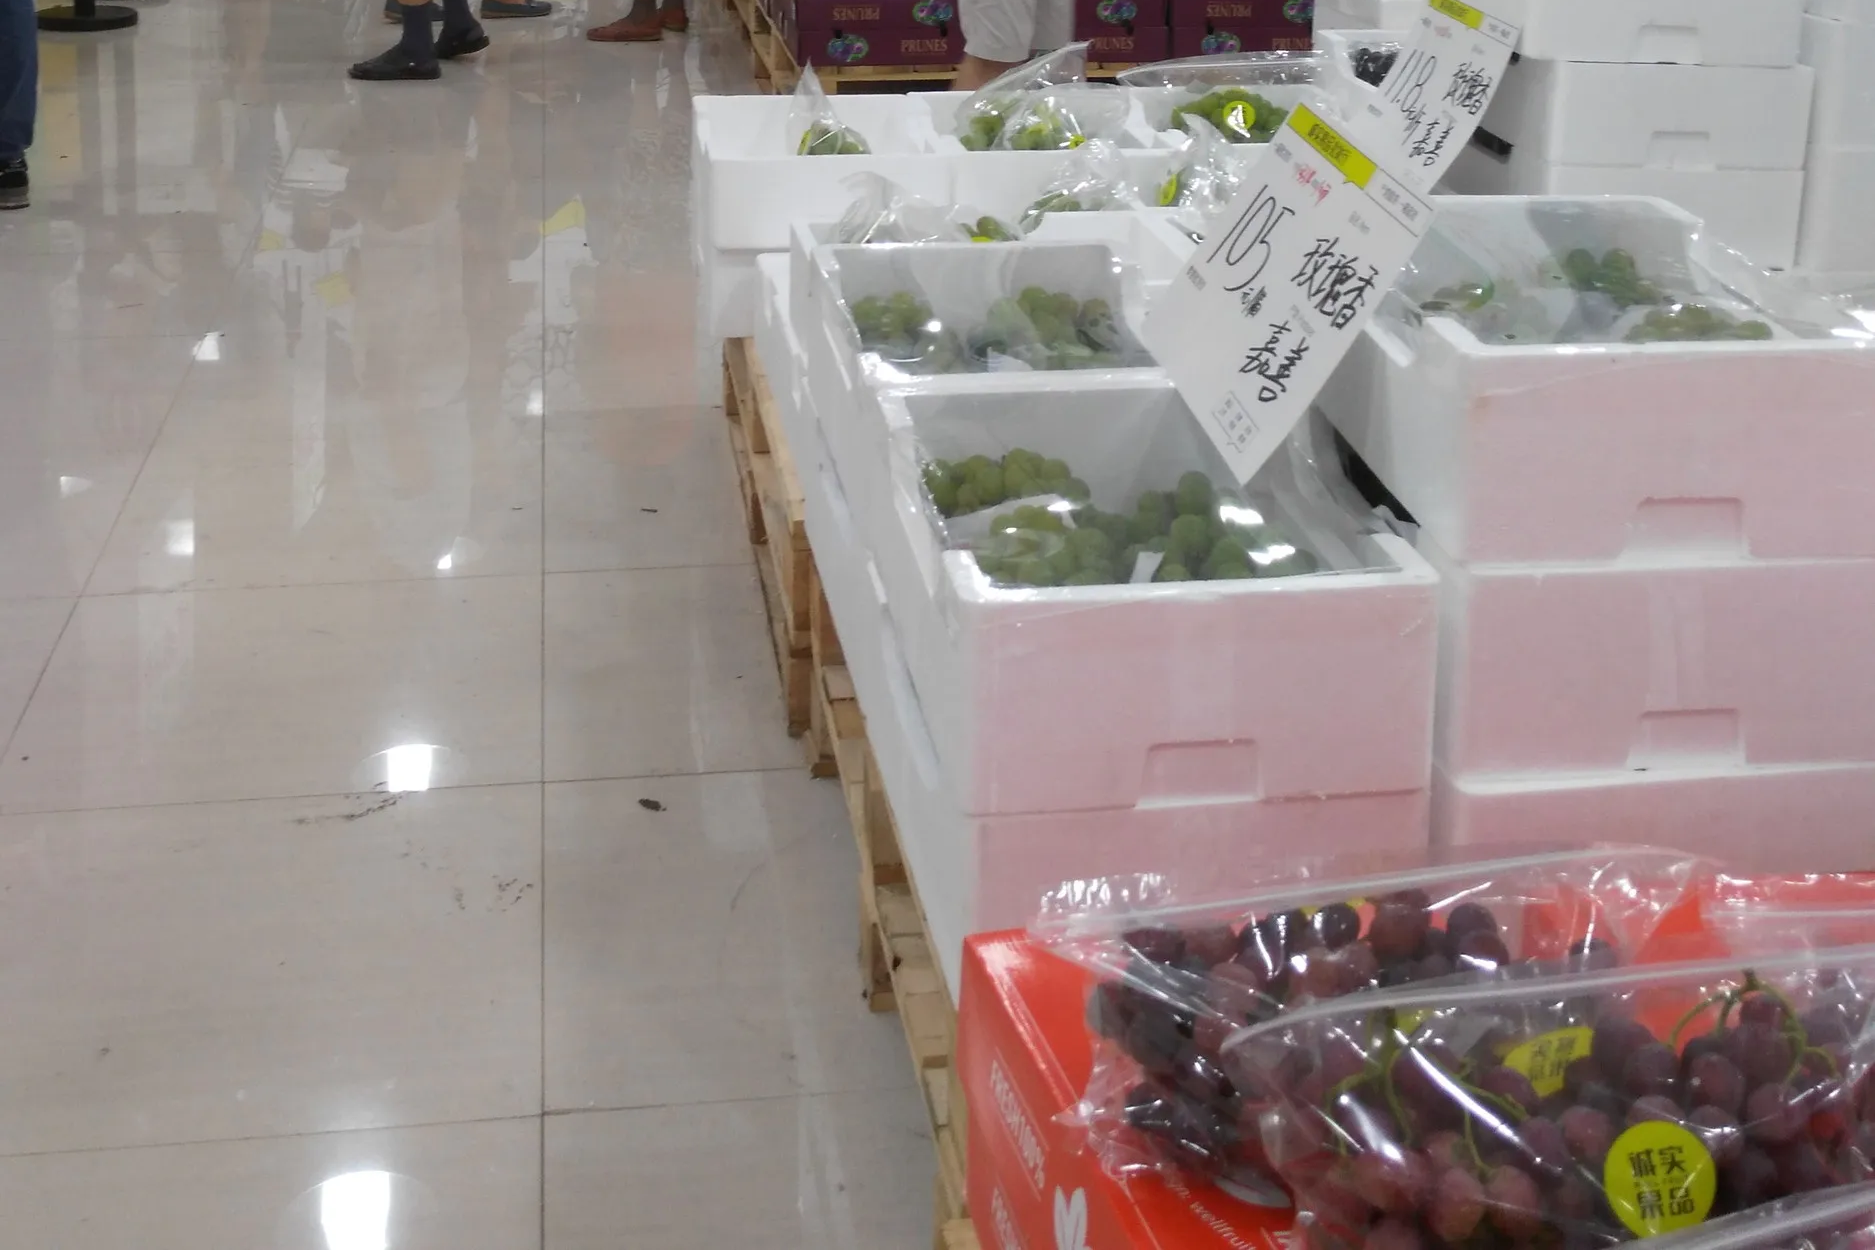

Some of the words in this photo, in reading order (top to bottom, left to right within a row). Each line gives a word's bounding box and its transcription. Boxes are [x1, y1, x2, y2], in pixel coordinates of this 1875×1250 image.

[901, 38, 949, 53] PRUNES
[1206, 184, 1295, 292] 105
[1635, 1186, 1695, 1221] 果品
